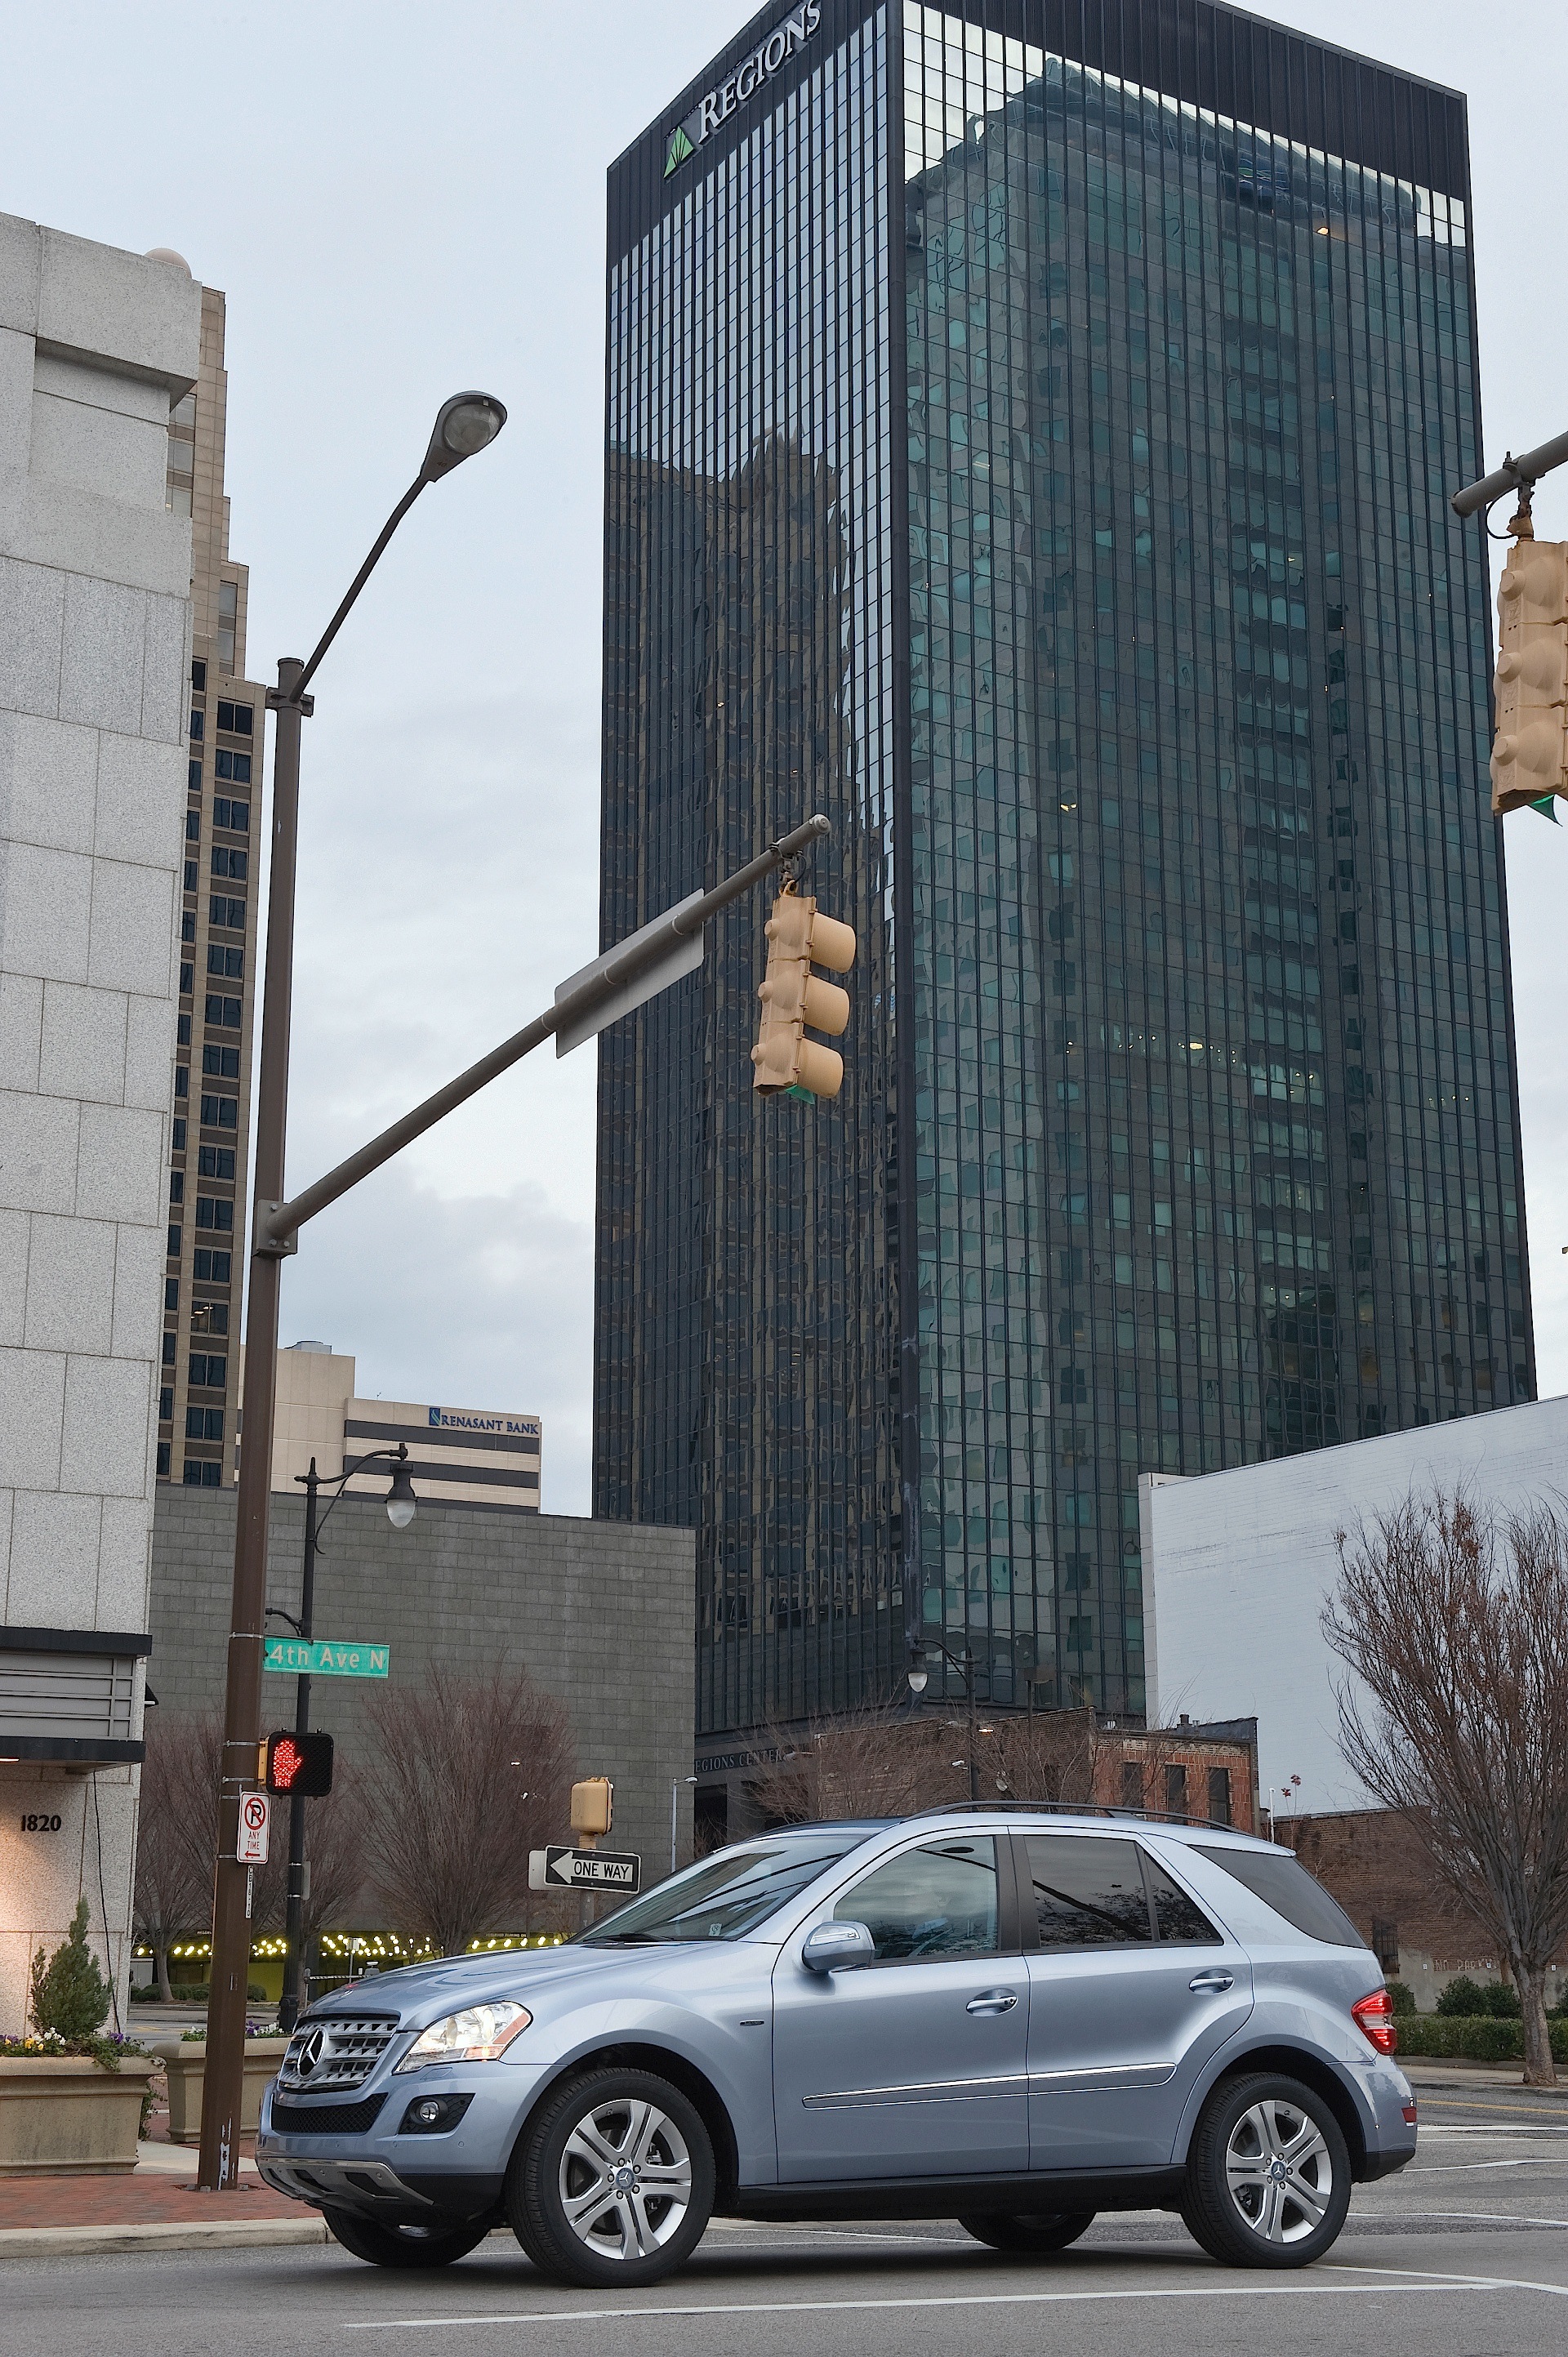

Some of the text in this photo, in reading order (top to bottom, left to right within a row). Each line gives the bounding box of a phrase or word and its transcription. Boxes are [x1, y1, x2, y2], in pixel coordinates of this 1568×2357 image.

[698, 0, 821, 145] REGIONS
[441, 1415, 539, 1434] RENASANT BANK
[270, 1644, 384, 1670] 4th Ave N
[694, 1754, 734, 1772] EGIONS
[21, 1814, 62, 1831] 1820
[248, 1831, 261, 1840] ANY
[247, 1840, 261, 1851] TIME
[573, 1860, 630, 1880] ONE WAY
